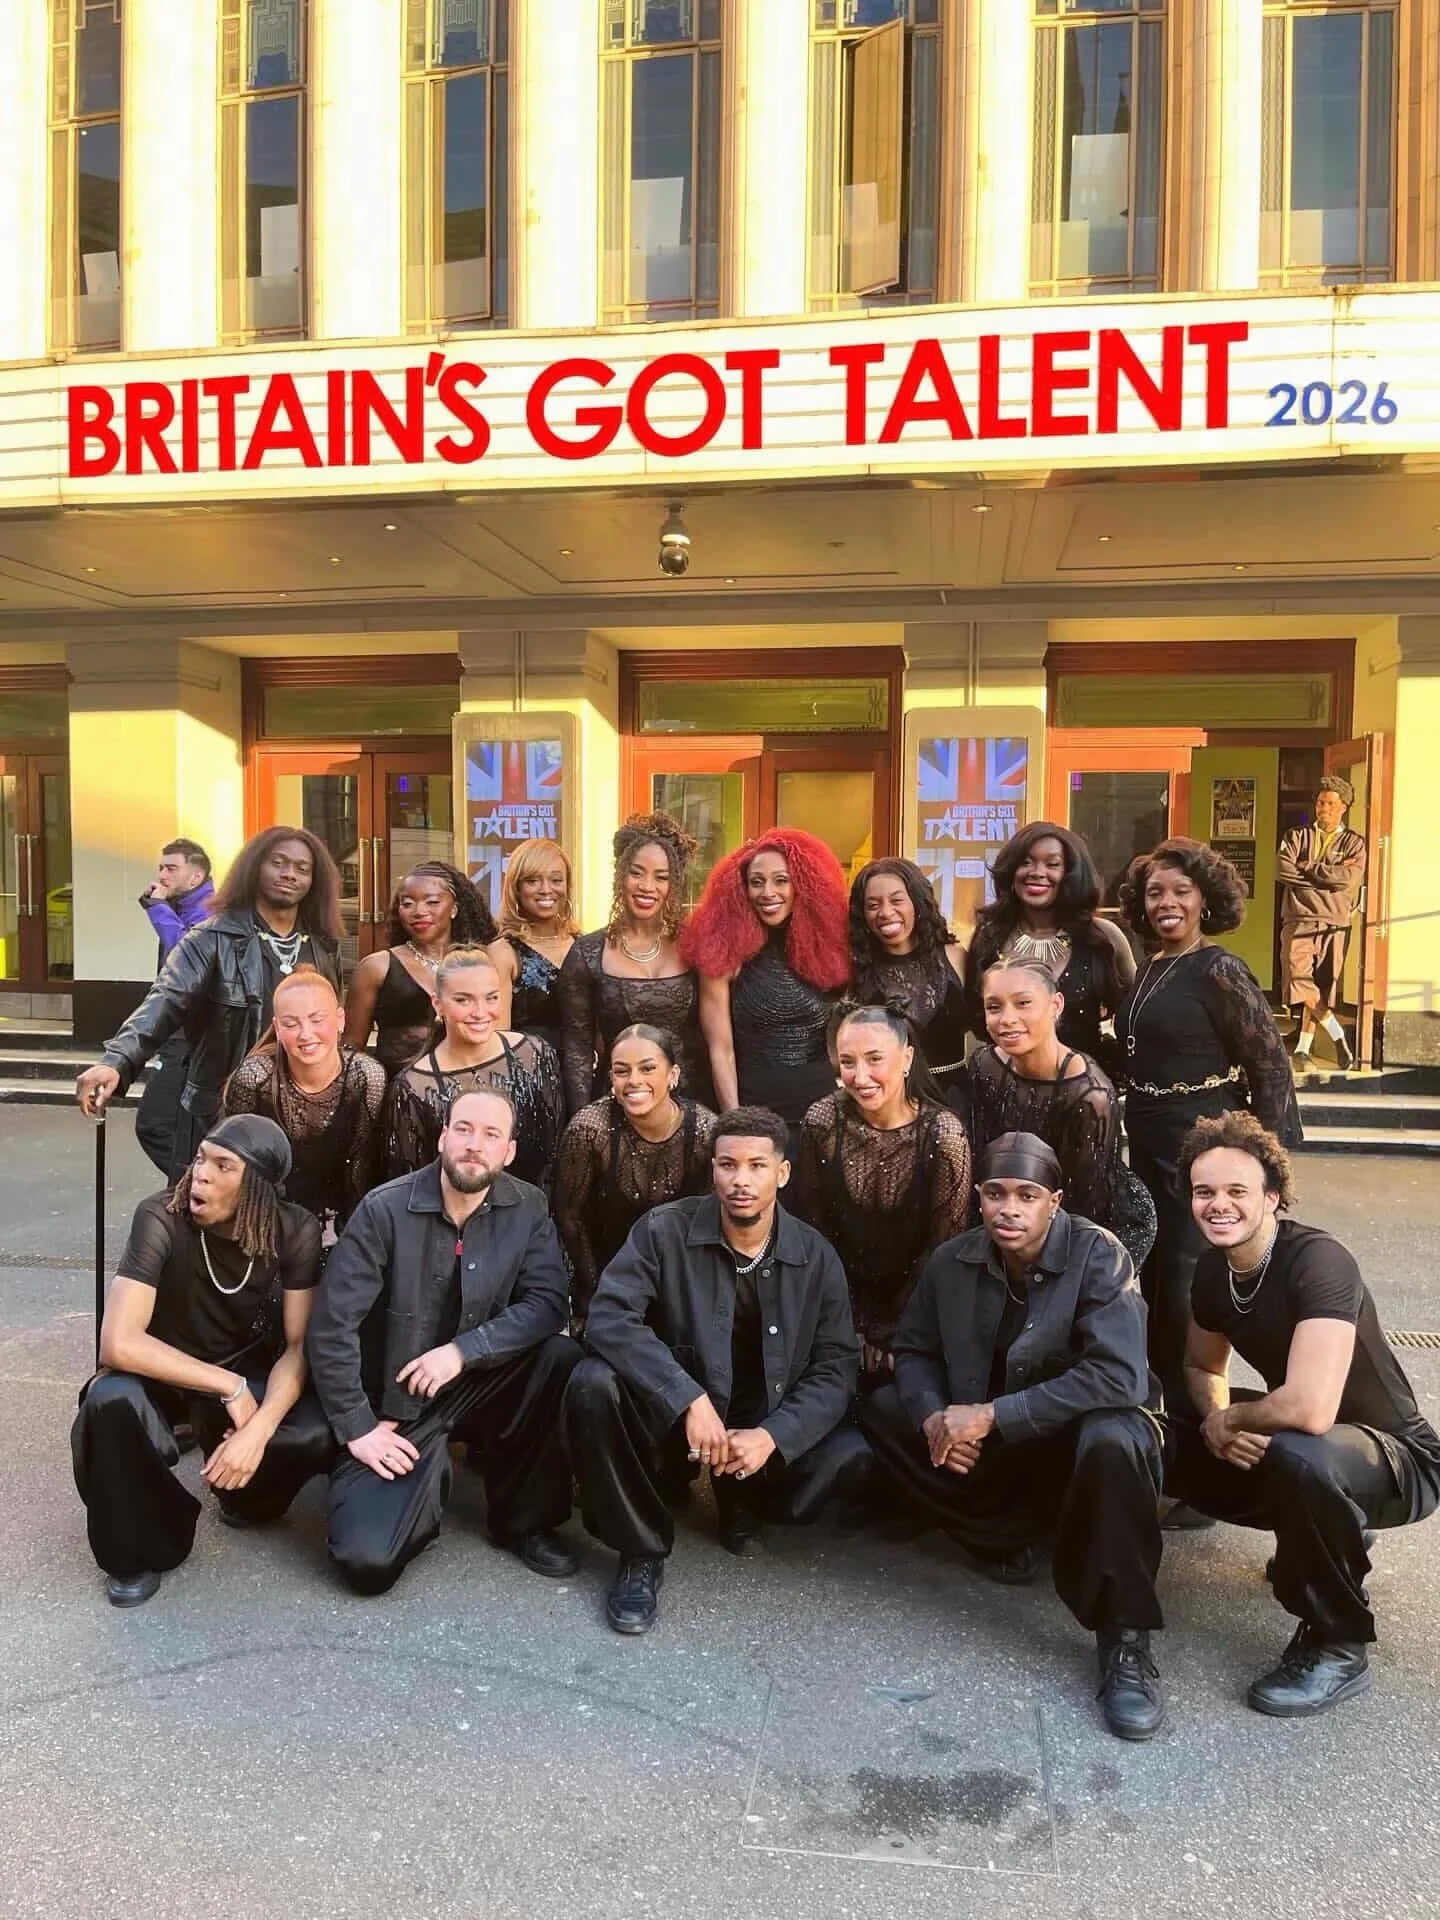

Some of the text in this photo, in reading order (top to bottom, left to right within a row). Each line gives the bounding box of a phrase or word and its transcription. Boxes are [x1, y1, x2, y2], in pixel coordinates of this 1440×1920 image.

[67, 321, 1399, 479] BRITAIN'S GOT TALENT 2026
[473, 808, 557, 839] TALENT
[924, 808, 1018, 841] TALENT
